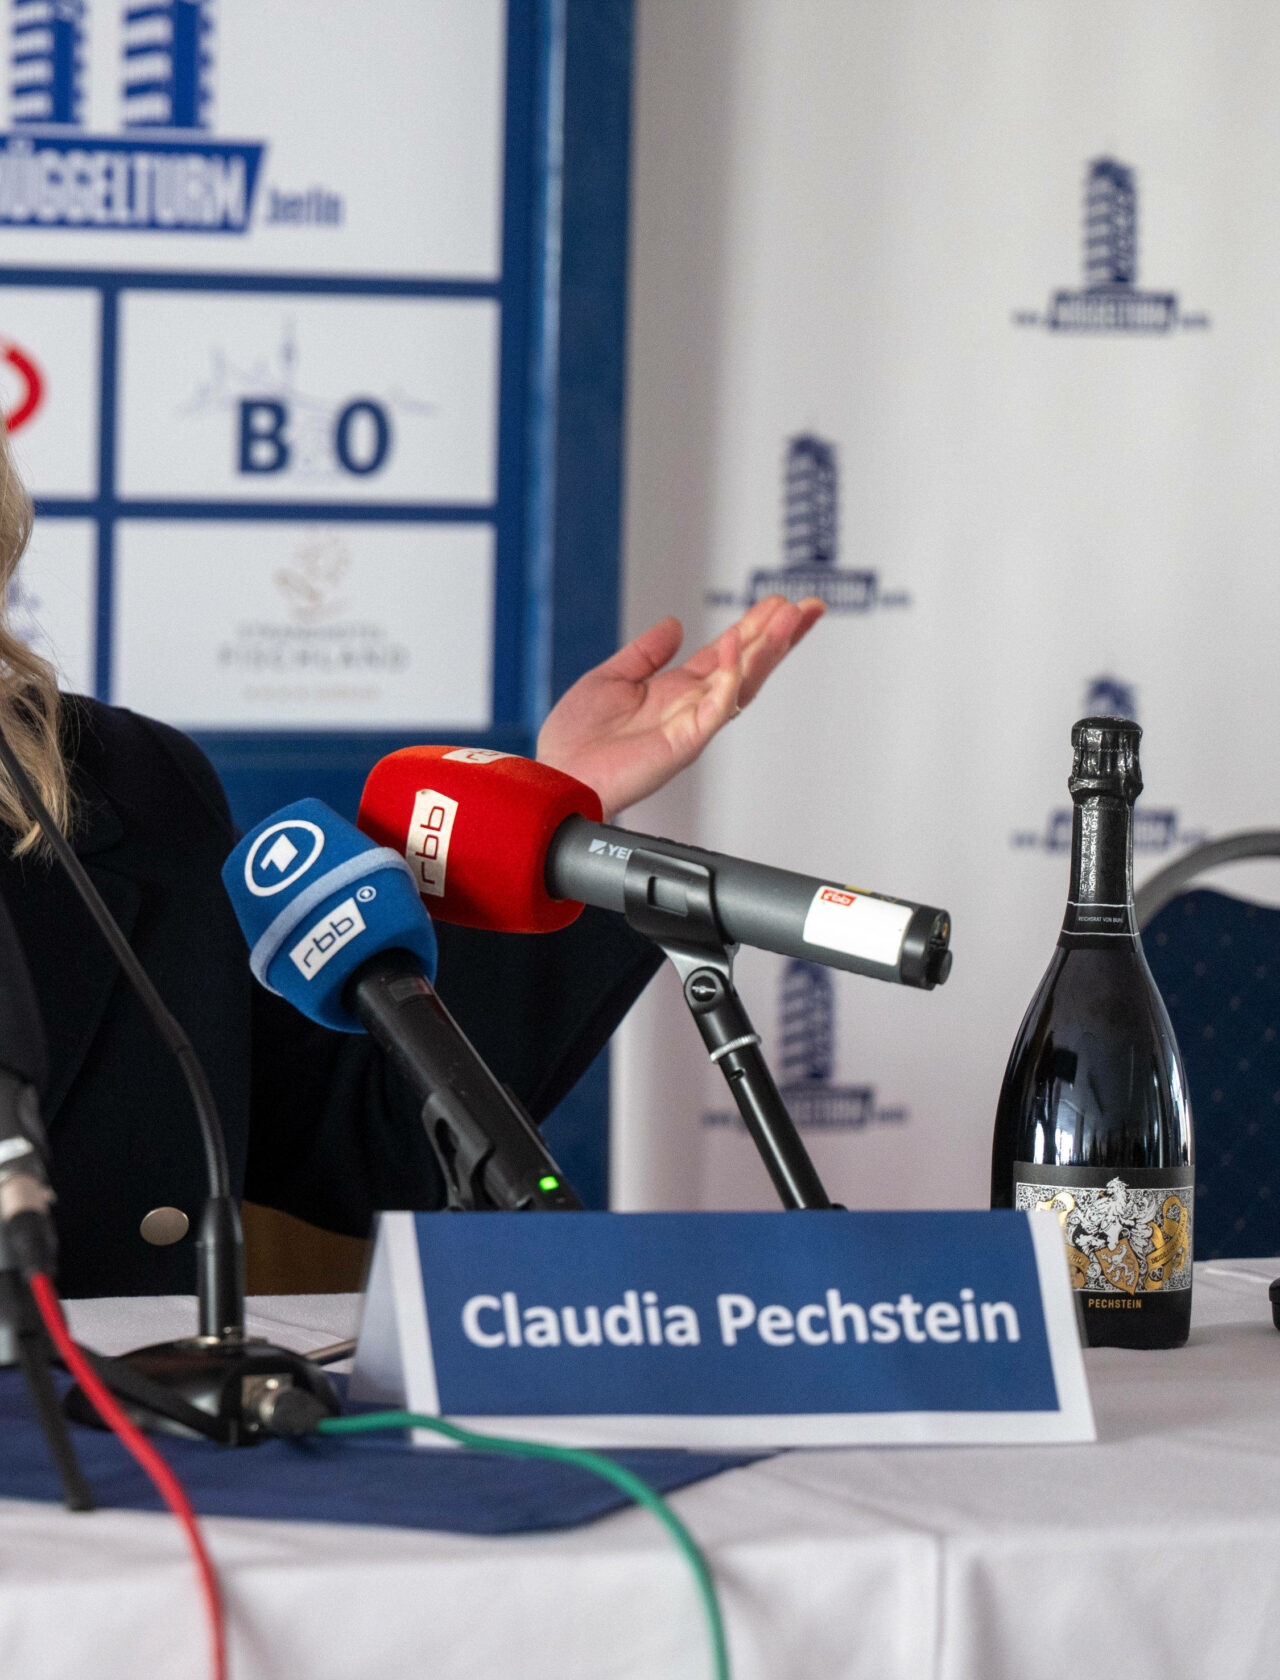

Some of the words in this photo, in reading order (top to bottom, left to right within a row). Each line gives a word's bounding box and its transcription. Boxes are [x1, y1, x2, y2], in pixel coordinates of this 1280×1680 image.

[415, 806, 445, 885] rbb
[303, 917, 355, 968] rbb
[461, 1290, 701, 1348] Claudia
[717, 1288, 1022, 1347] Pechstein
[1087, 1298, 1143, 1309] PECHSTEIN
